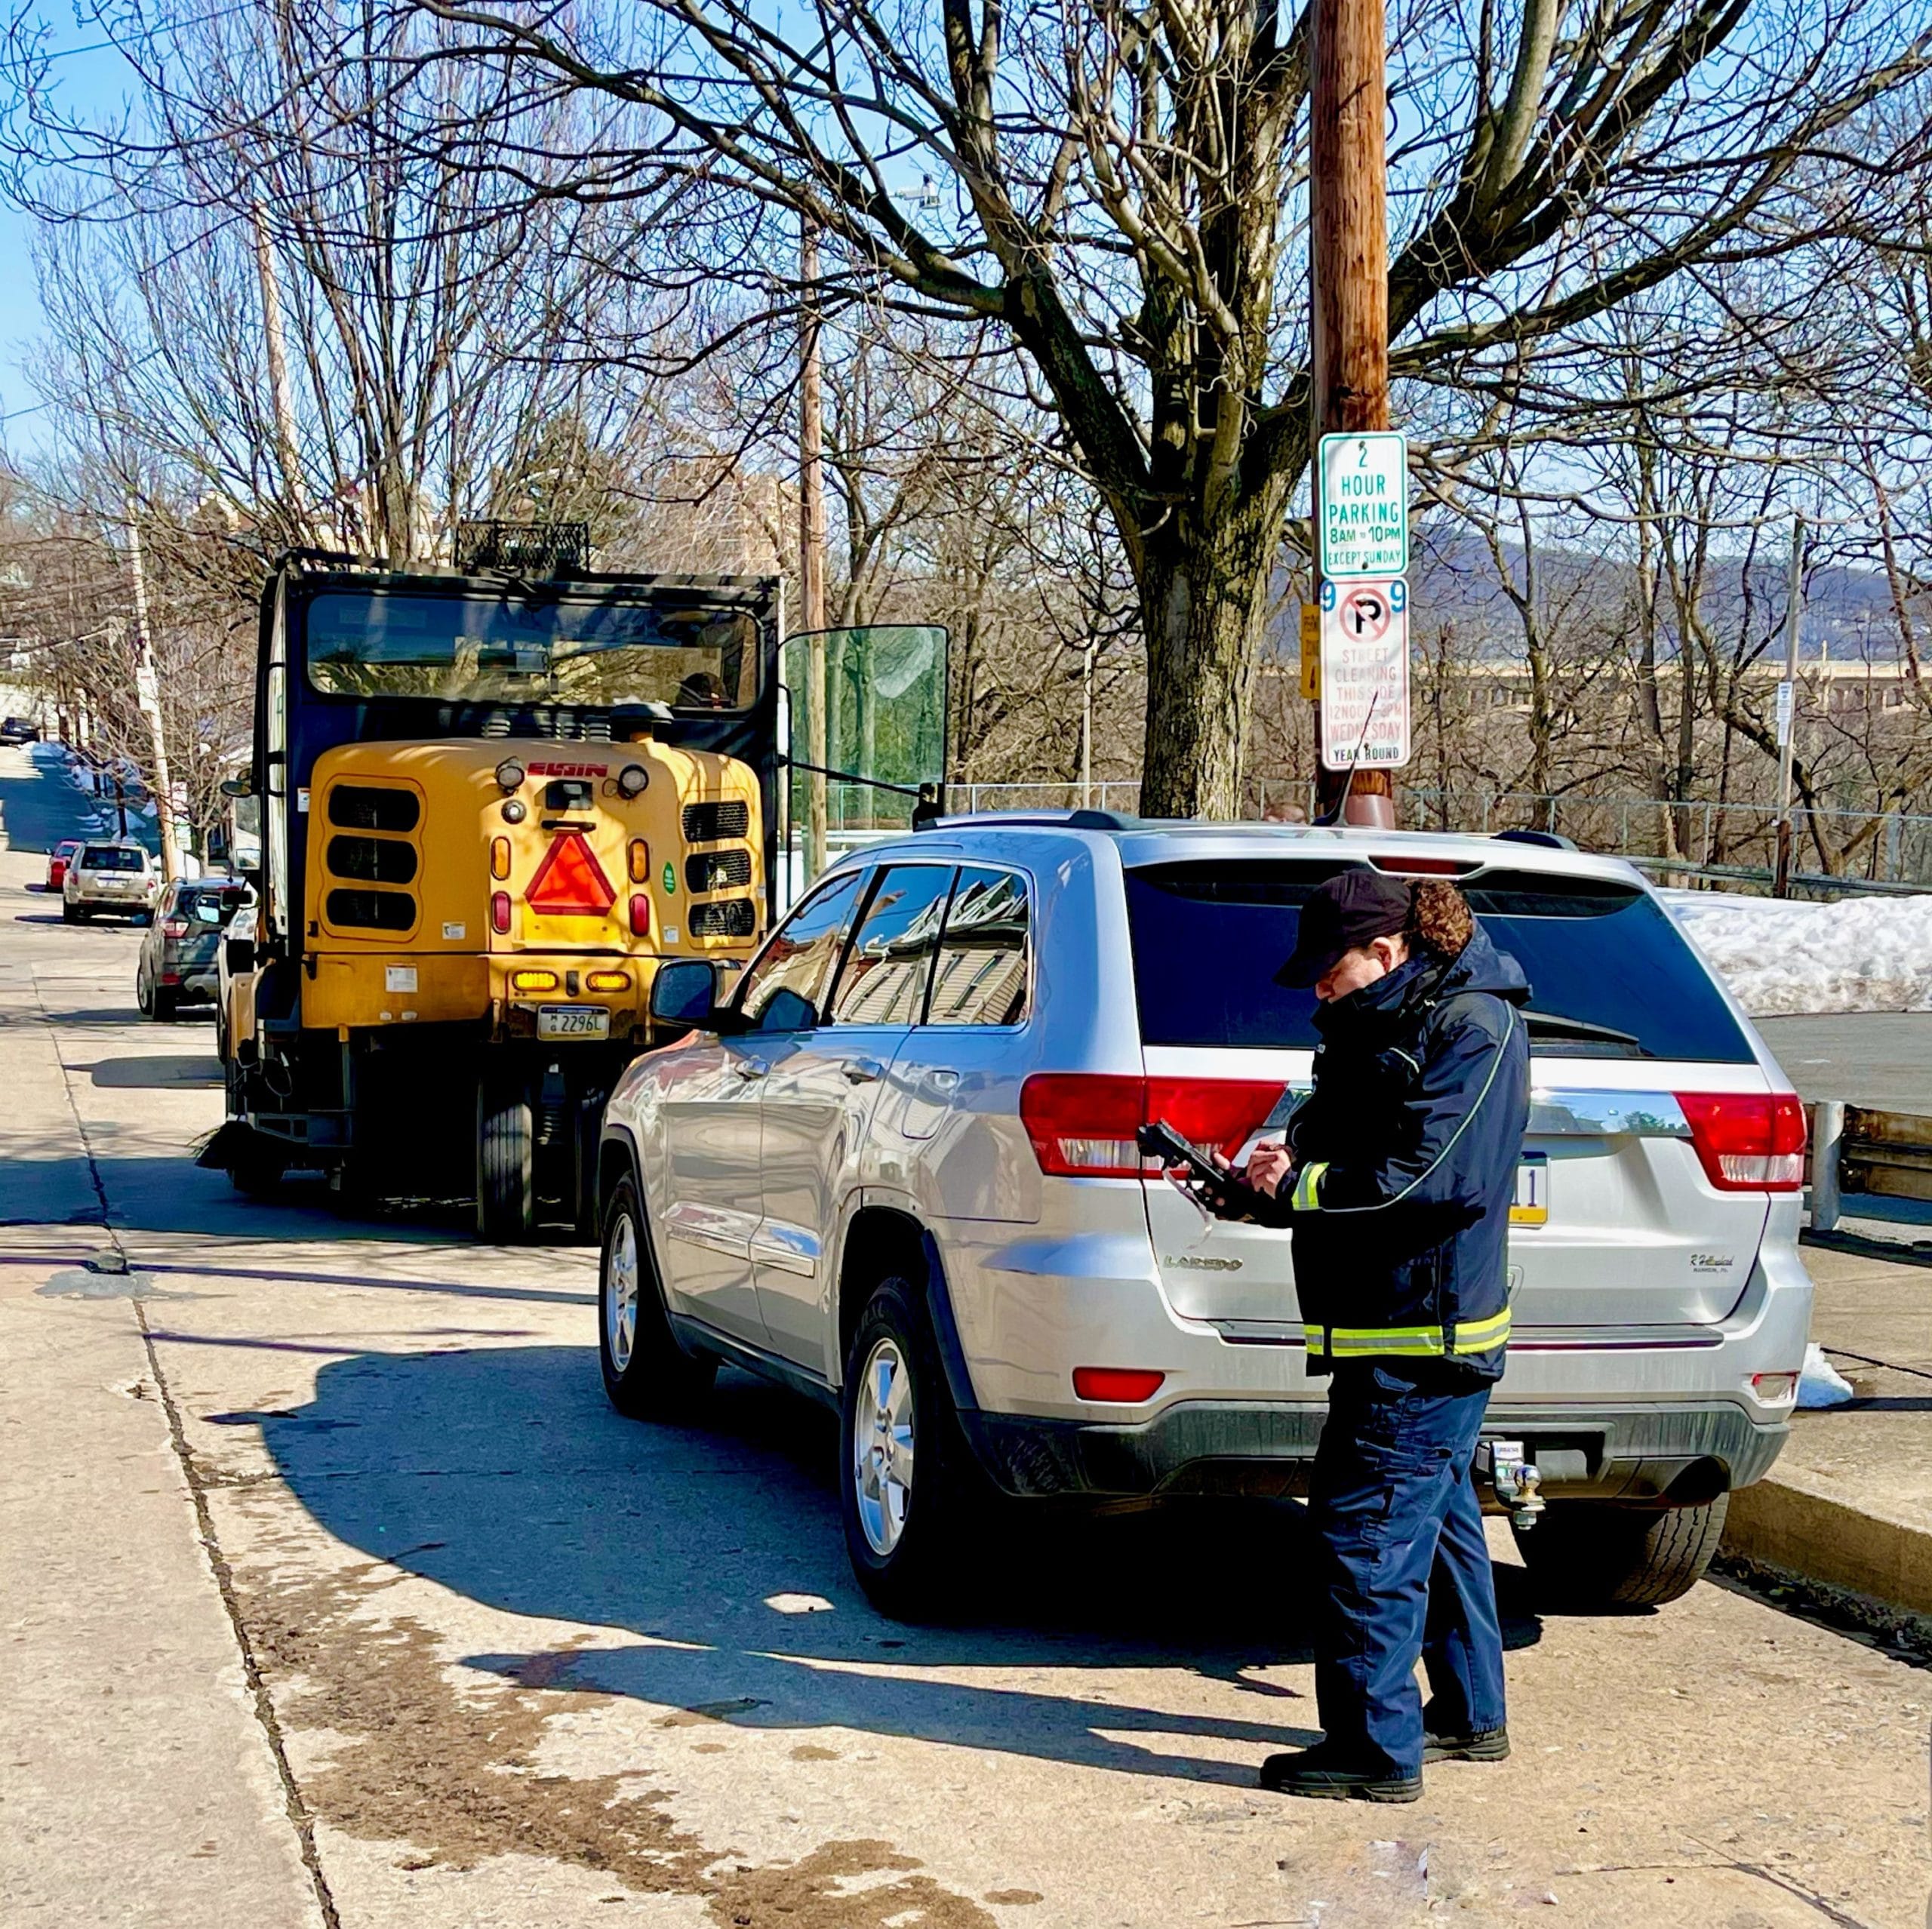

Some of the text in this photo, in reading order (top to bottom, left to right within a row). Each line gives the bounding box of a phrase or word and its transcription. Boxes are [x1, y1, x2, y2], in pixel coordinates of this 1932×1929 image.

[1358, 447, 1368, 467] 2
[1341, 475, 1386, 497] HOUR
[1329, 501, 1399, 525] PARKING
[1330, 528, 1356, 544] 8AM
[1368, 526, 1401, 543] 10PM
[1328, 549, 1401, 565] EXCEPT SUNDAY
[1320, 580, 1337, 612] 9
[1390, 580, 1406, 613] 9
[1342, 647, 1389, 664] STREET
[1334, 665, 1397, 683] CLEANING
[1337, 684, 1395, 701] THIS SIDE
[1330, 721, 1402, 742] WEDNESDAY
[1334, 746, 1399, 762] YEAR ROUND
[528, 762, 609, 777] ELGIN
[561, 1015, 602, 1032] 2296L
